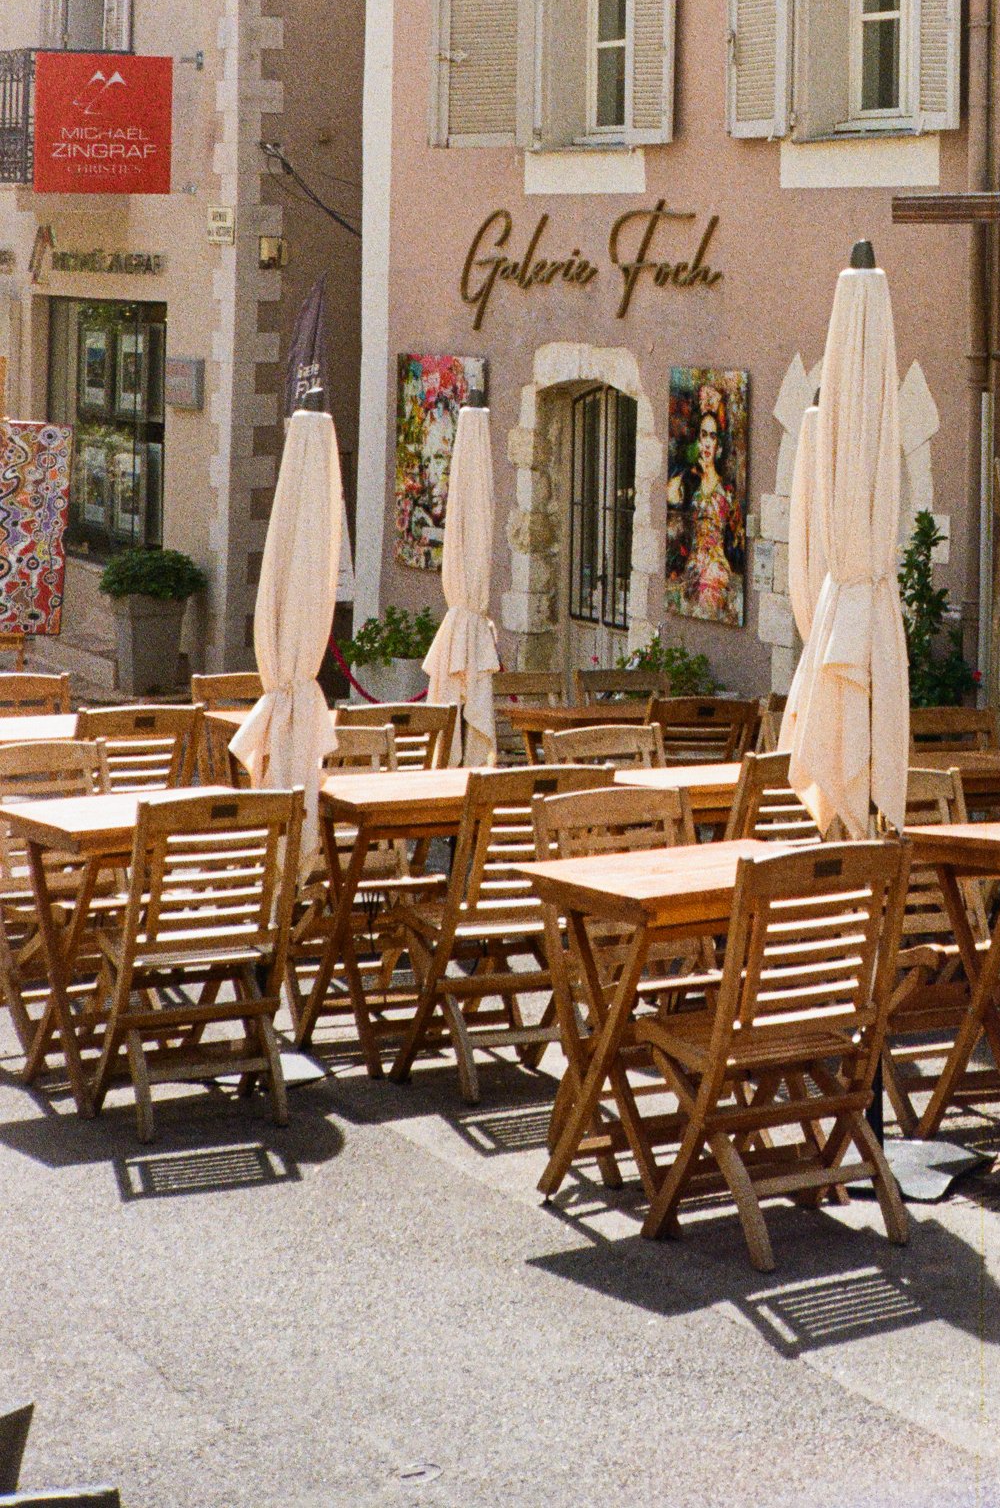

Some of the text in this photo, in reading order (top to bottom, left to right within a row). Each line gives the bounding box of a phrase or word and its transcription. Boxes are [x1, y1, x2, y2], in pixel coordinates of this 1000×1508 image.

[60, 126, 150, 141] MICHAËL
[51, 142, 157, 159] ZINGRAF
[460, 198, 725, 331] Galerie Foch
